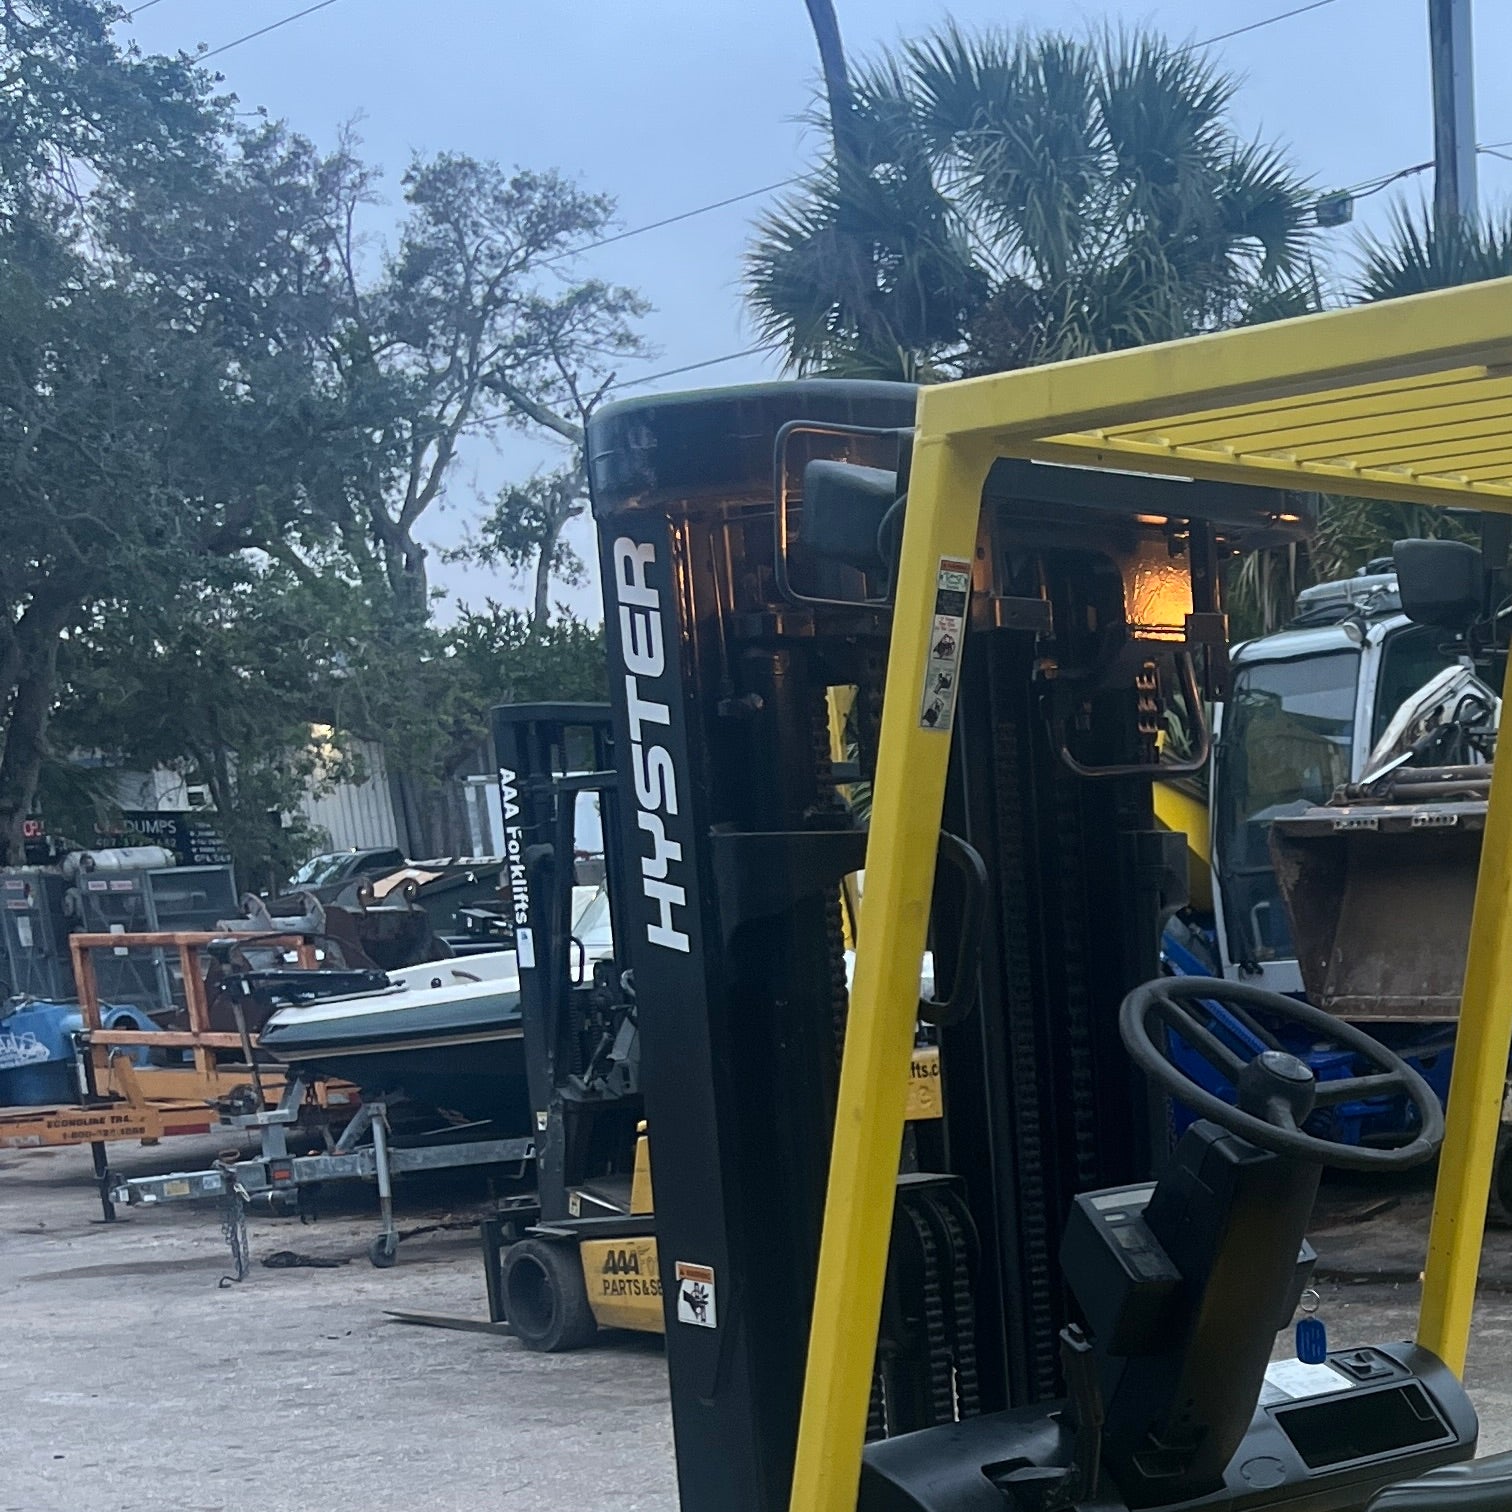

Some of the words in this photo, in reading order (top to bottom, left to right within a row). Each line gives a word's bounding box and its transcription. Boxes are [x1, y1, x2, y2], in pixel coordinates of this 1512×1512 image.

[614, 536, 690, 953] HYSTER
[500, 767, 519, 820] AAA
[506, 826, 529, 925] Forklifts
[602, 1250, 640, 1275] AAA
